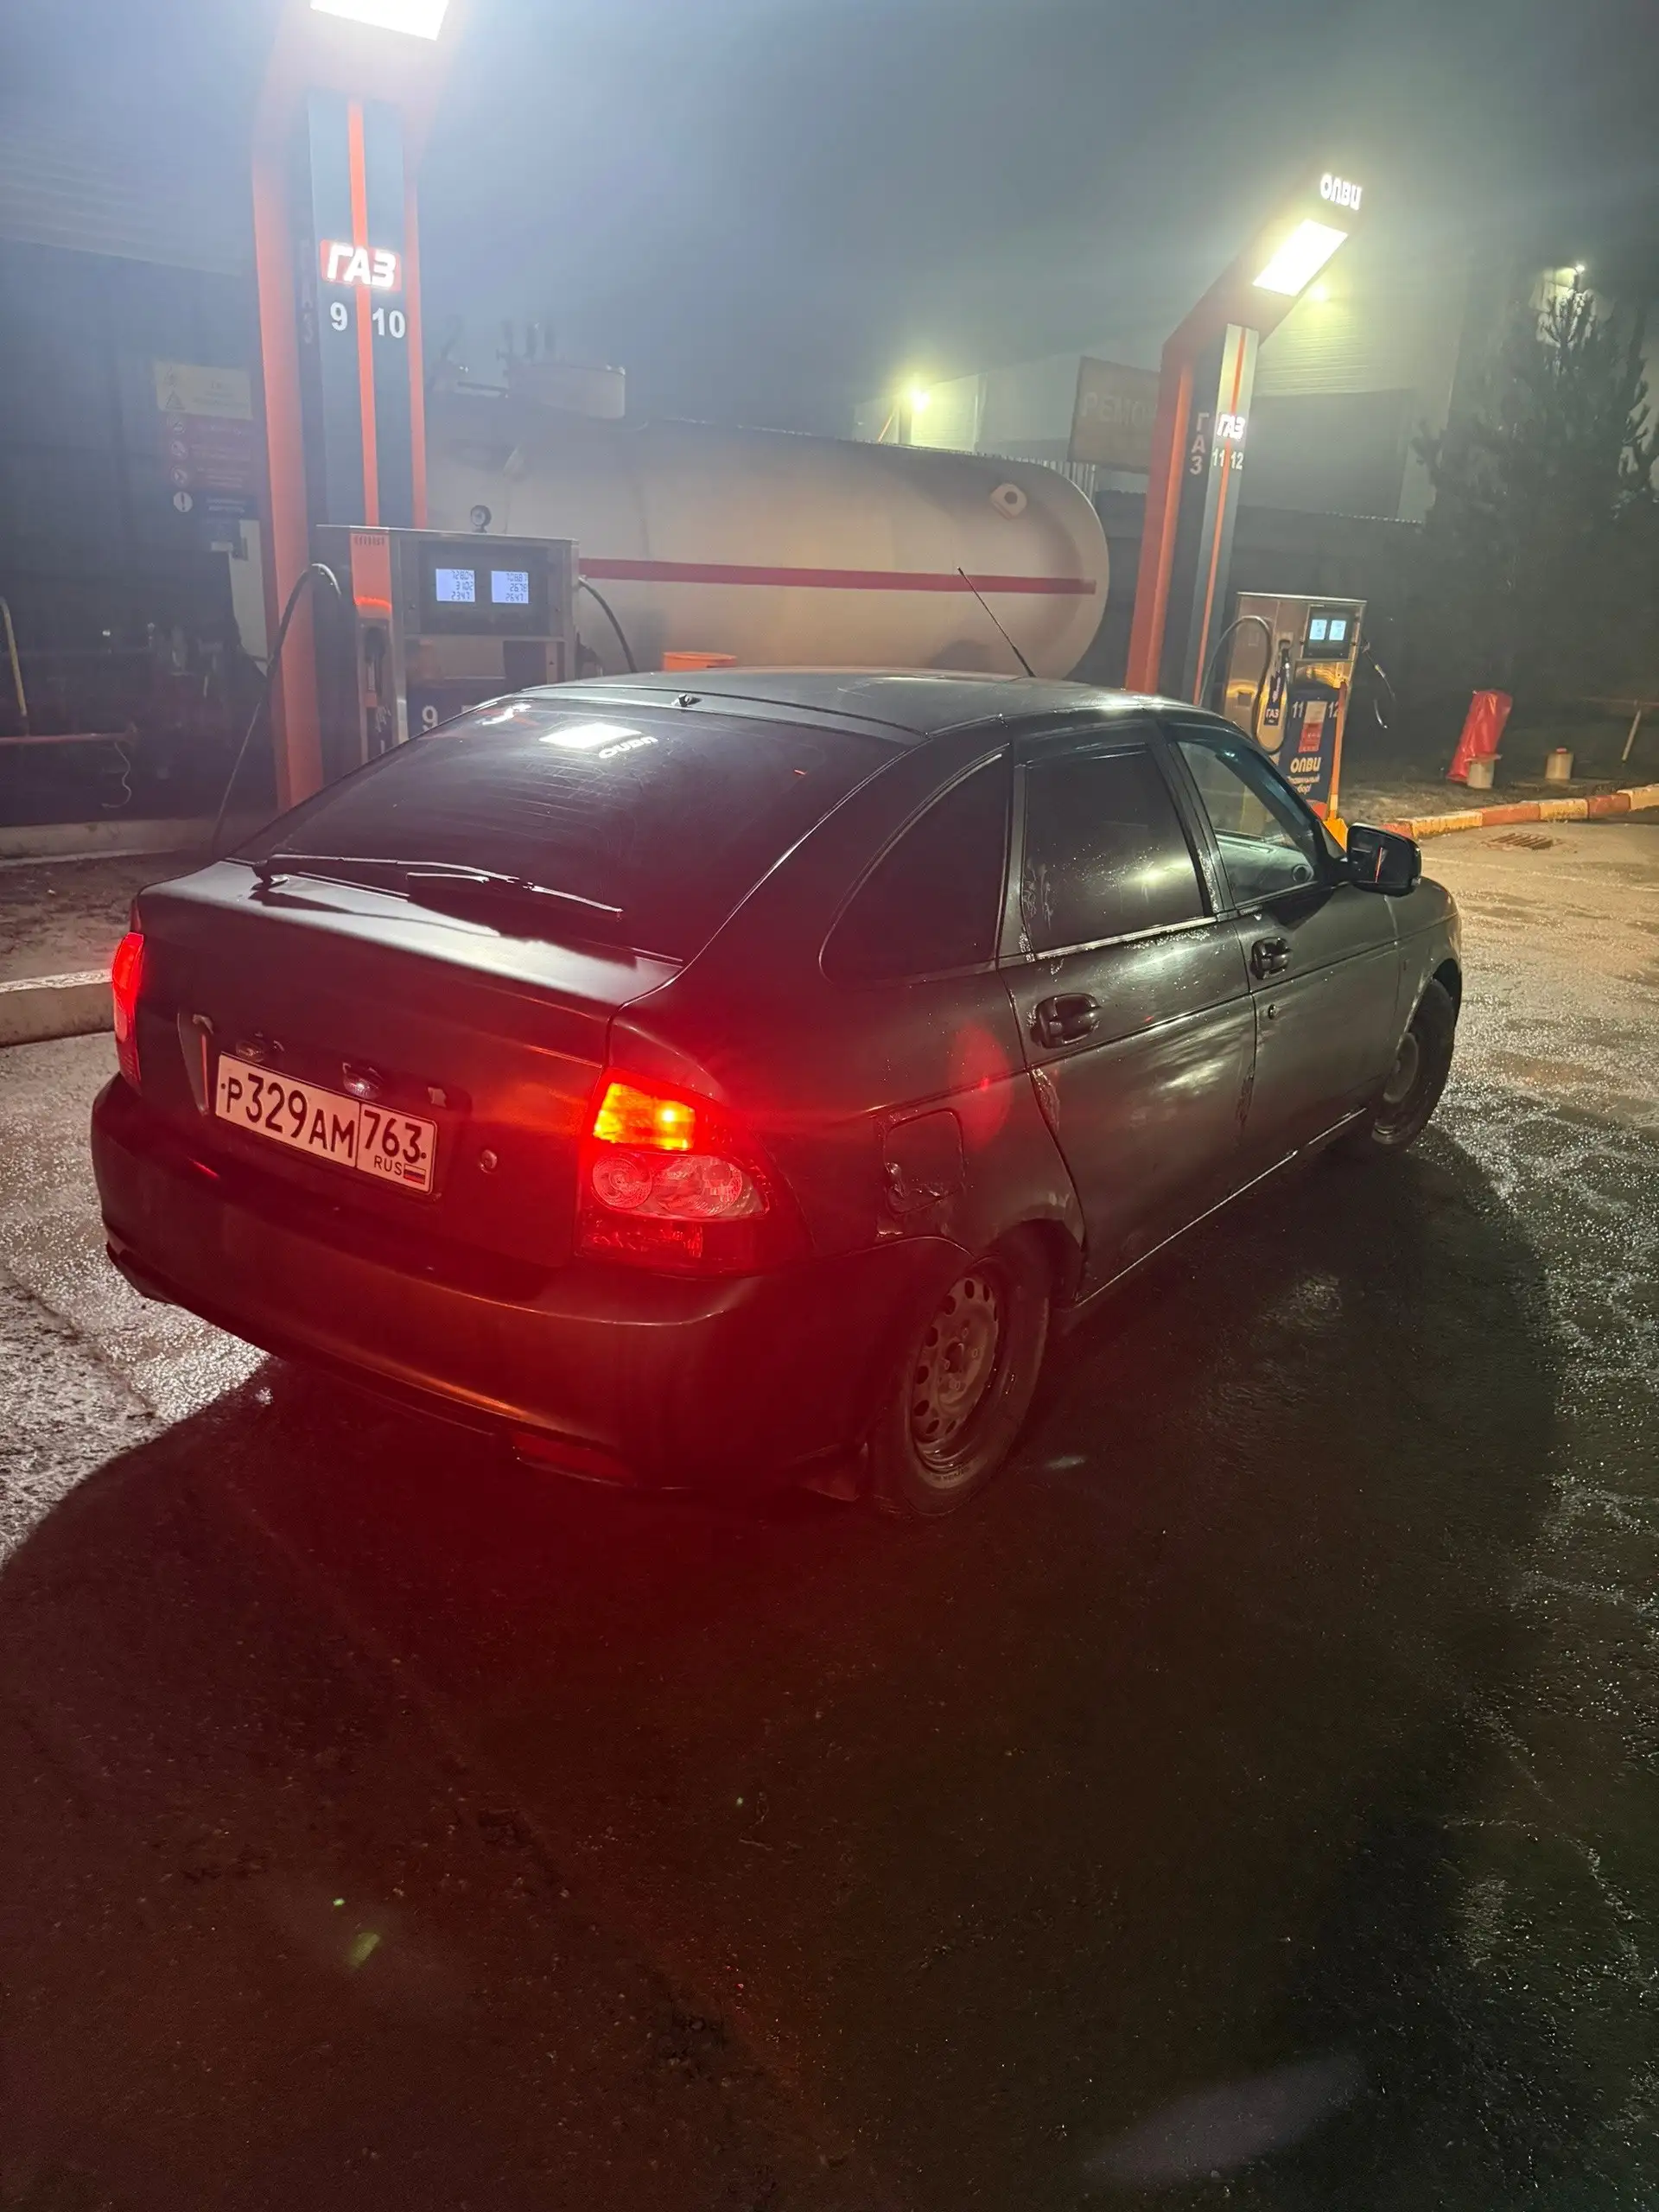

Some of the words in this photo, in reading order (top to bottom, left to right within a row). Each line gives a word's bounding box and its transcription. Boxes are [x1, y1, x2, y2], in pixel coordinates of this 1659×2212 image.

[327, 243, 397, 289] ГАЗ
[330, 302, 348, 332] 9
[372, 308, 406, 339] 10
[1216, 414, 1247, 441] ГАЗ
[1189, 412, 1211, 475] ГАЗ
[1212, 448, 1225, 467] 11
[1230, 451, 1244, 470] 12
[422, 705, 439, 732] 9
[1266, 708, 1280, 719] ГАЗ
[1292, 701, 1305, 719] 11
[363, 1109, 423, 1164] 763
[373, 1154, 403, 1177] RUS
